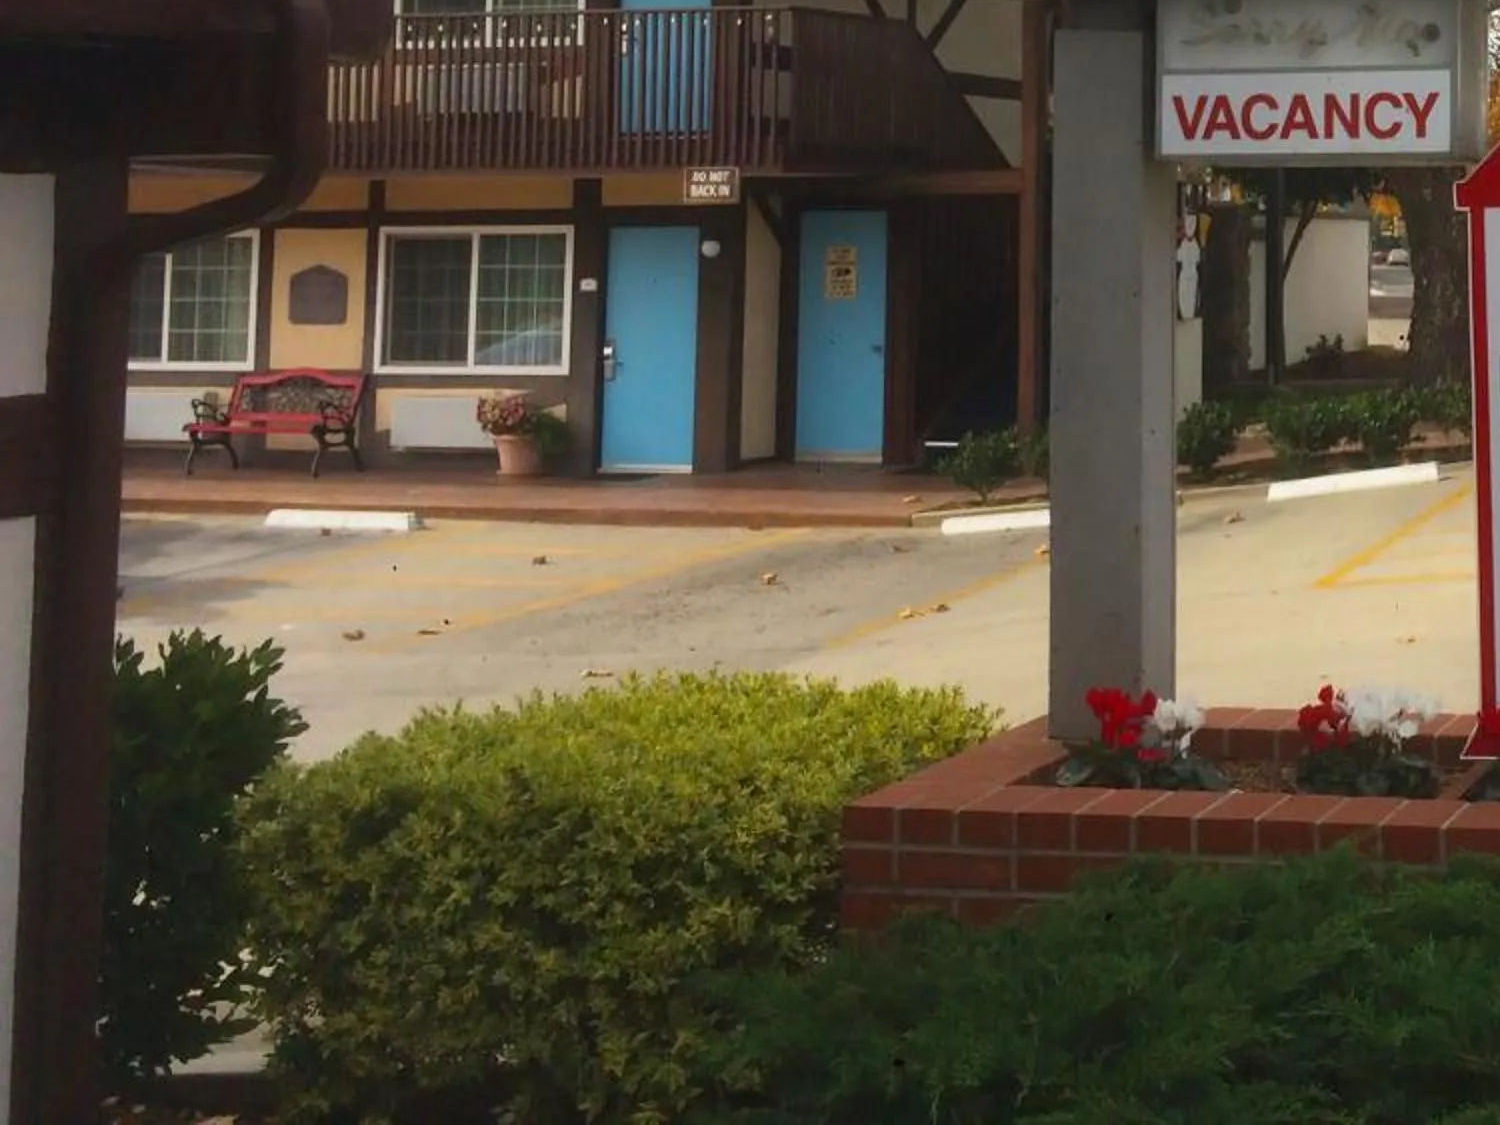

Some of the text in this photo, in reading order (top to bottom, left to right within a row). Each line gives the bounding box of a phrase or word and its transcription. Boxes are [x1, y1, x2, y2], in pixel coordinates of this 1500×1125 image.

[1171, 90, 1441, 141] VACANCY
[691, 170, 730, 182] DO NOT
[690, 184, 730, 198] BACK IN
